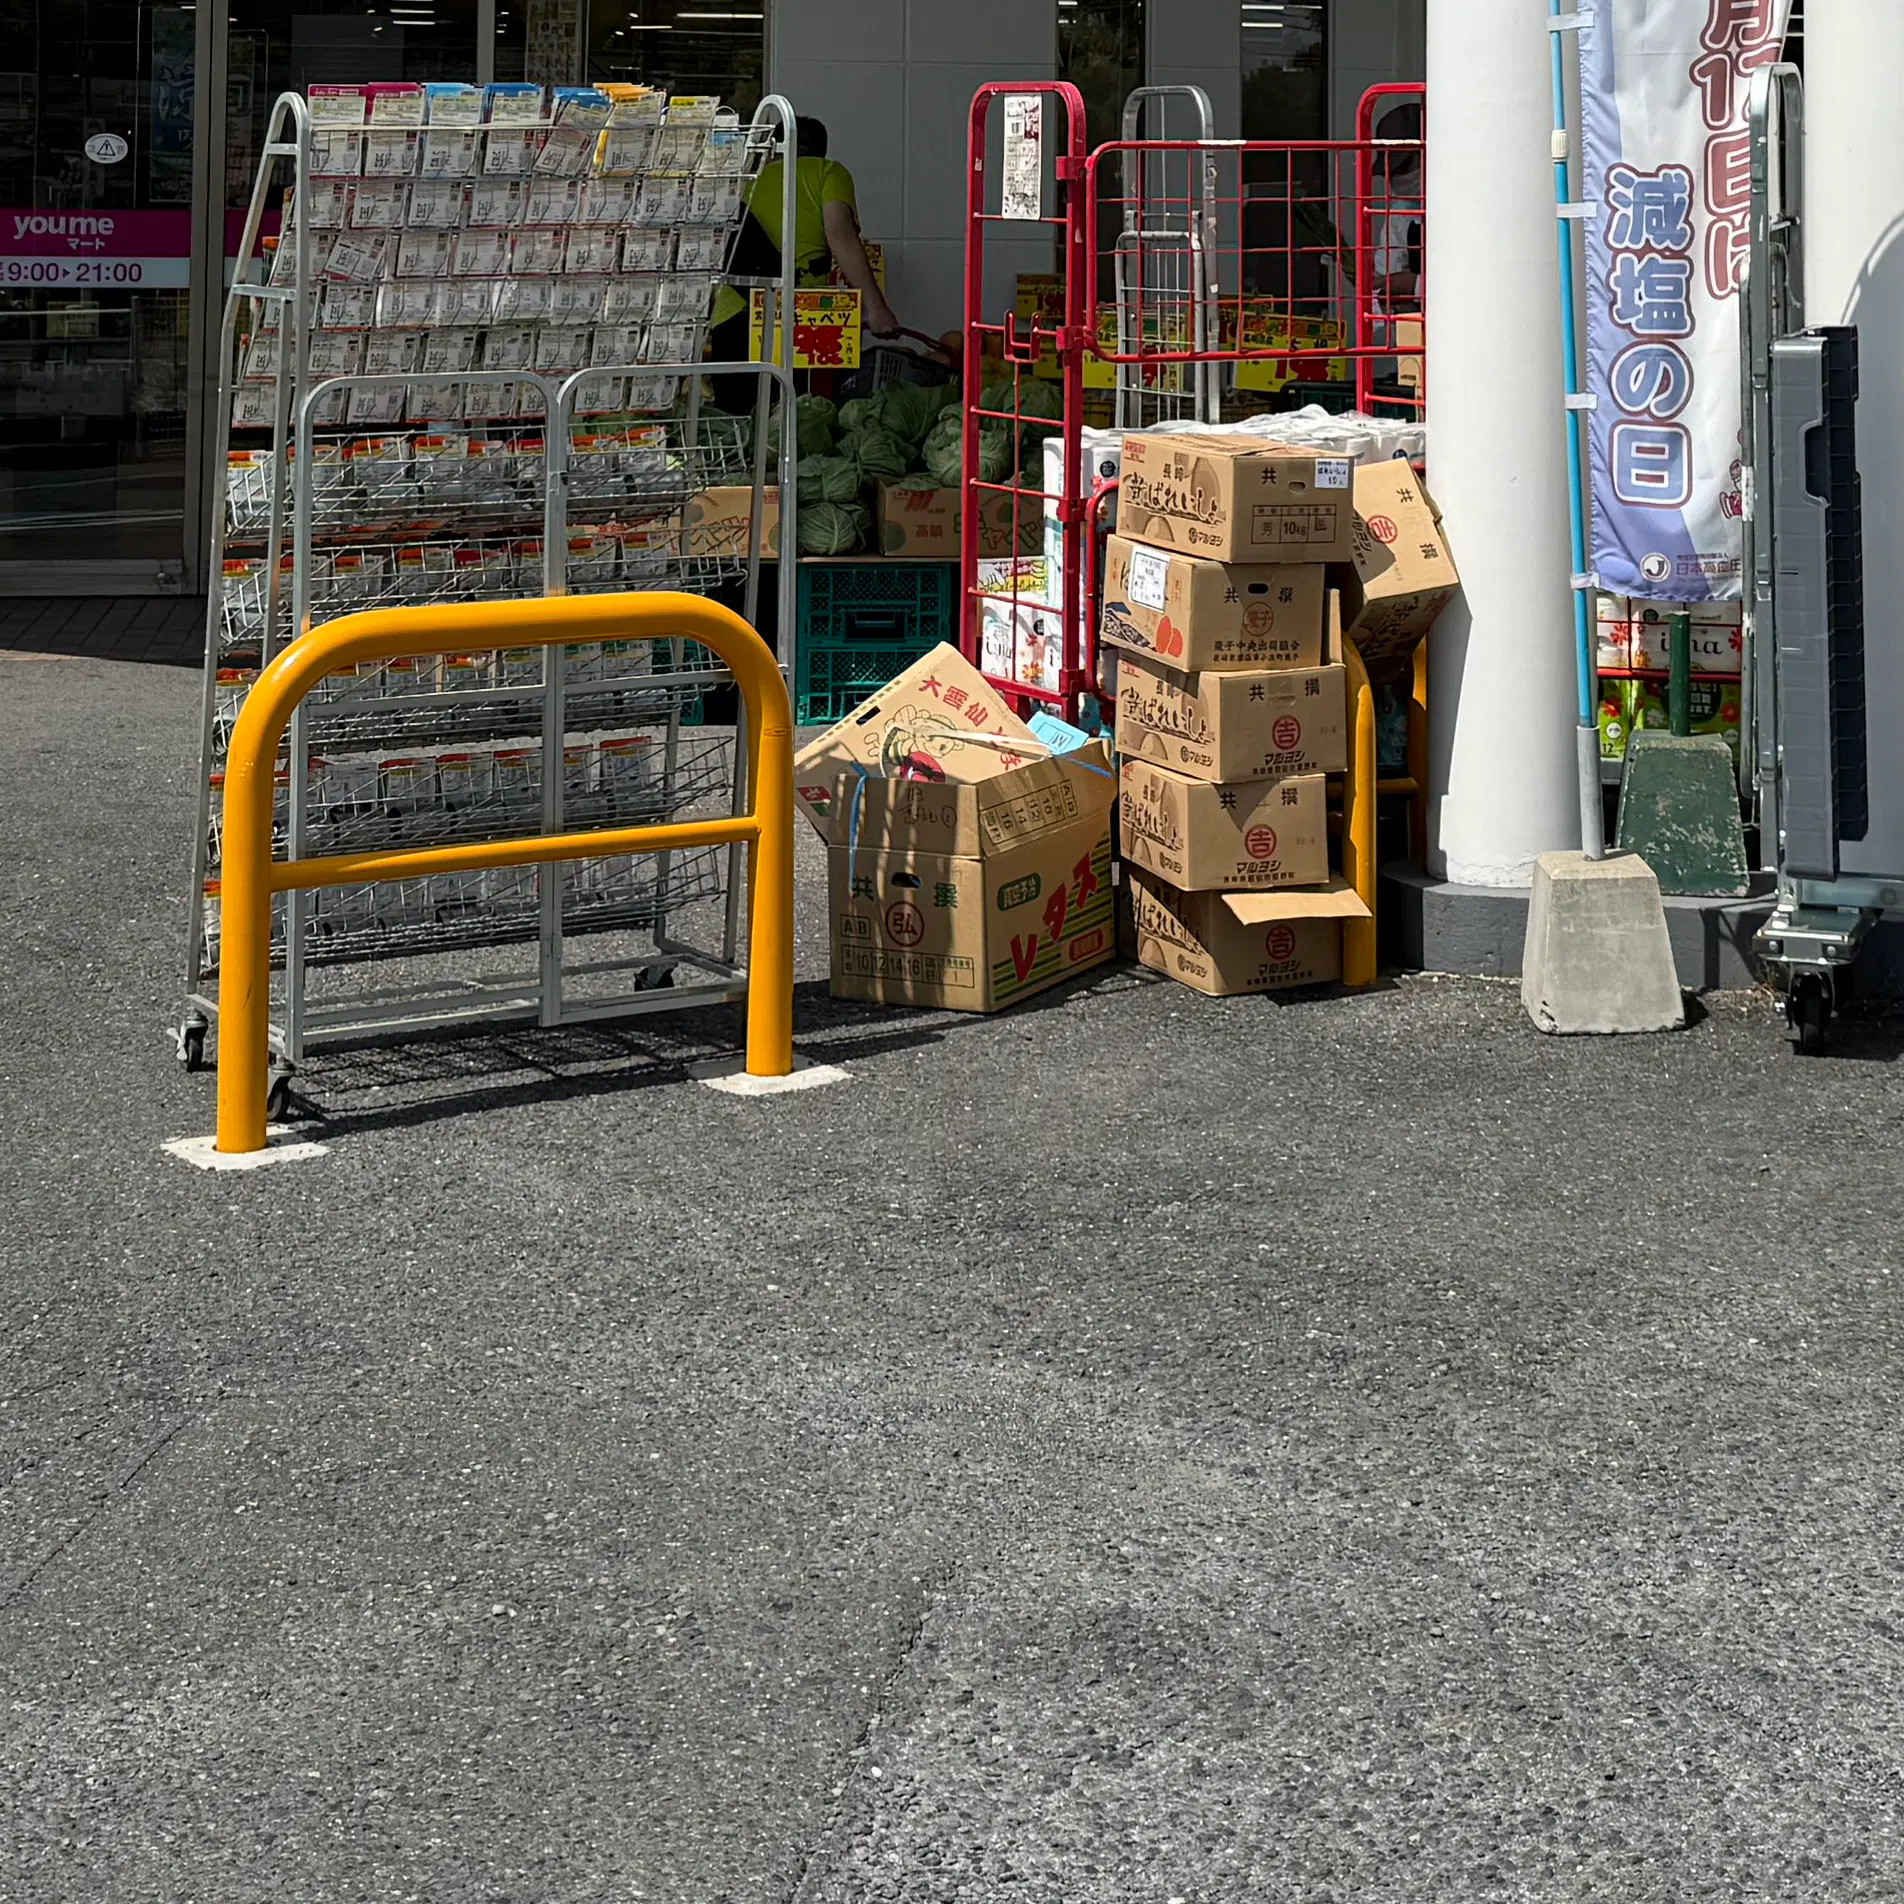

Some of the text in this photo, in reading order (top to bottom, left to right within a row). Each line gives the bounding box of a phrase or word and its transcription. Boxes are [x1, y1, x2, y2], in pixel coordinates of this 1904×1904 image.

[67, 238, 105, 250] マート
[8, 262, 142, 282] 9:00 21:00
[1603, 162, 1695, 509] 減塩の日
[1261, 467, 1277, 485] 共
[1396, 487, 1415, 503] 共
[1198, 531, 1223, 546] マルヨシ
[1224, 588, 1240, 603] 共
[1249, 684, 1265, 701] 共
[1275, 718, 1298, 746] 吉
[1189, 751, 1214, 767] マルヨシ
[1264, 751, 1306, 765] マルヨシ
[1220, 791, 1237, 809] 共
[1249, 827, 1272, 854] 吉
[1236, 860, 1283, 874] マルヨシ
[852, 876, 874, 900] 共
[844, 919, 868, 935] A B
[857, 954, 869, 971] 10
[875, 956, 886, 971] 12
[890, 958, 903, 975] 14
[907, 959, 921, 976] 16
[1259, 961, 1300, 976] マルヨシ
